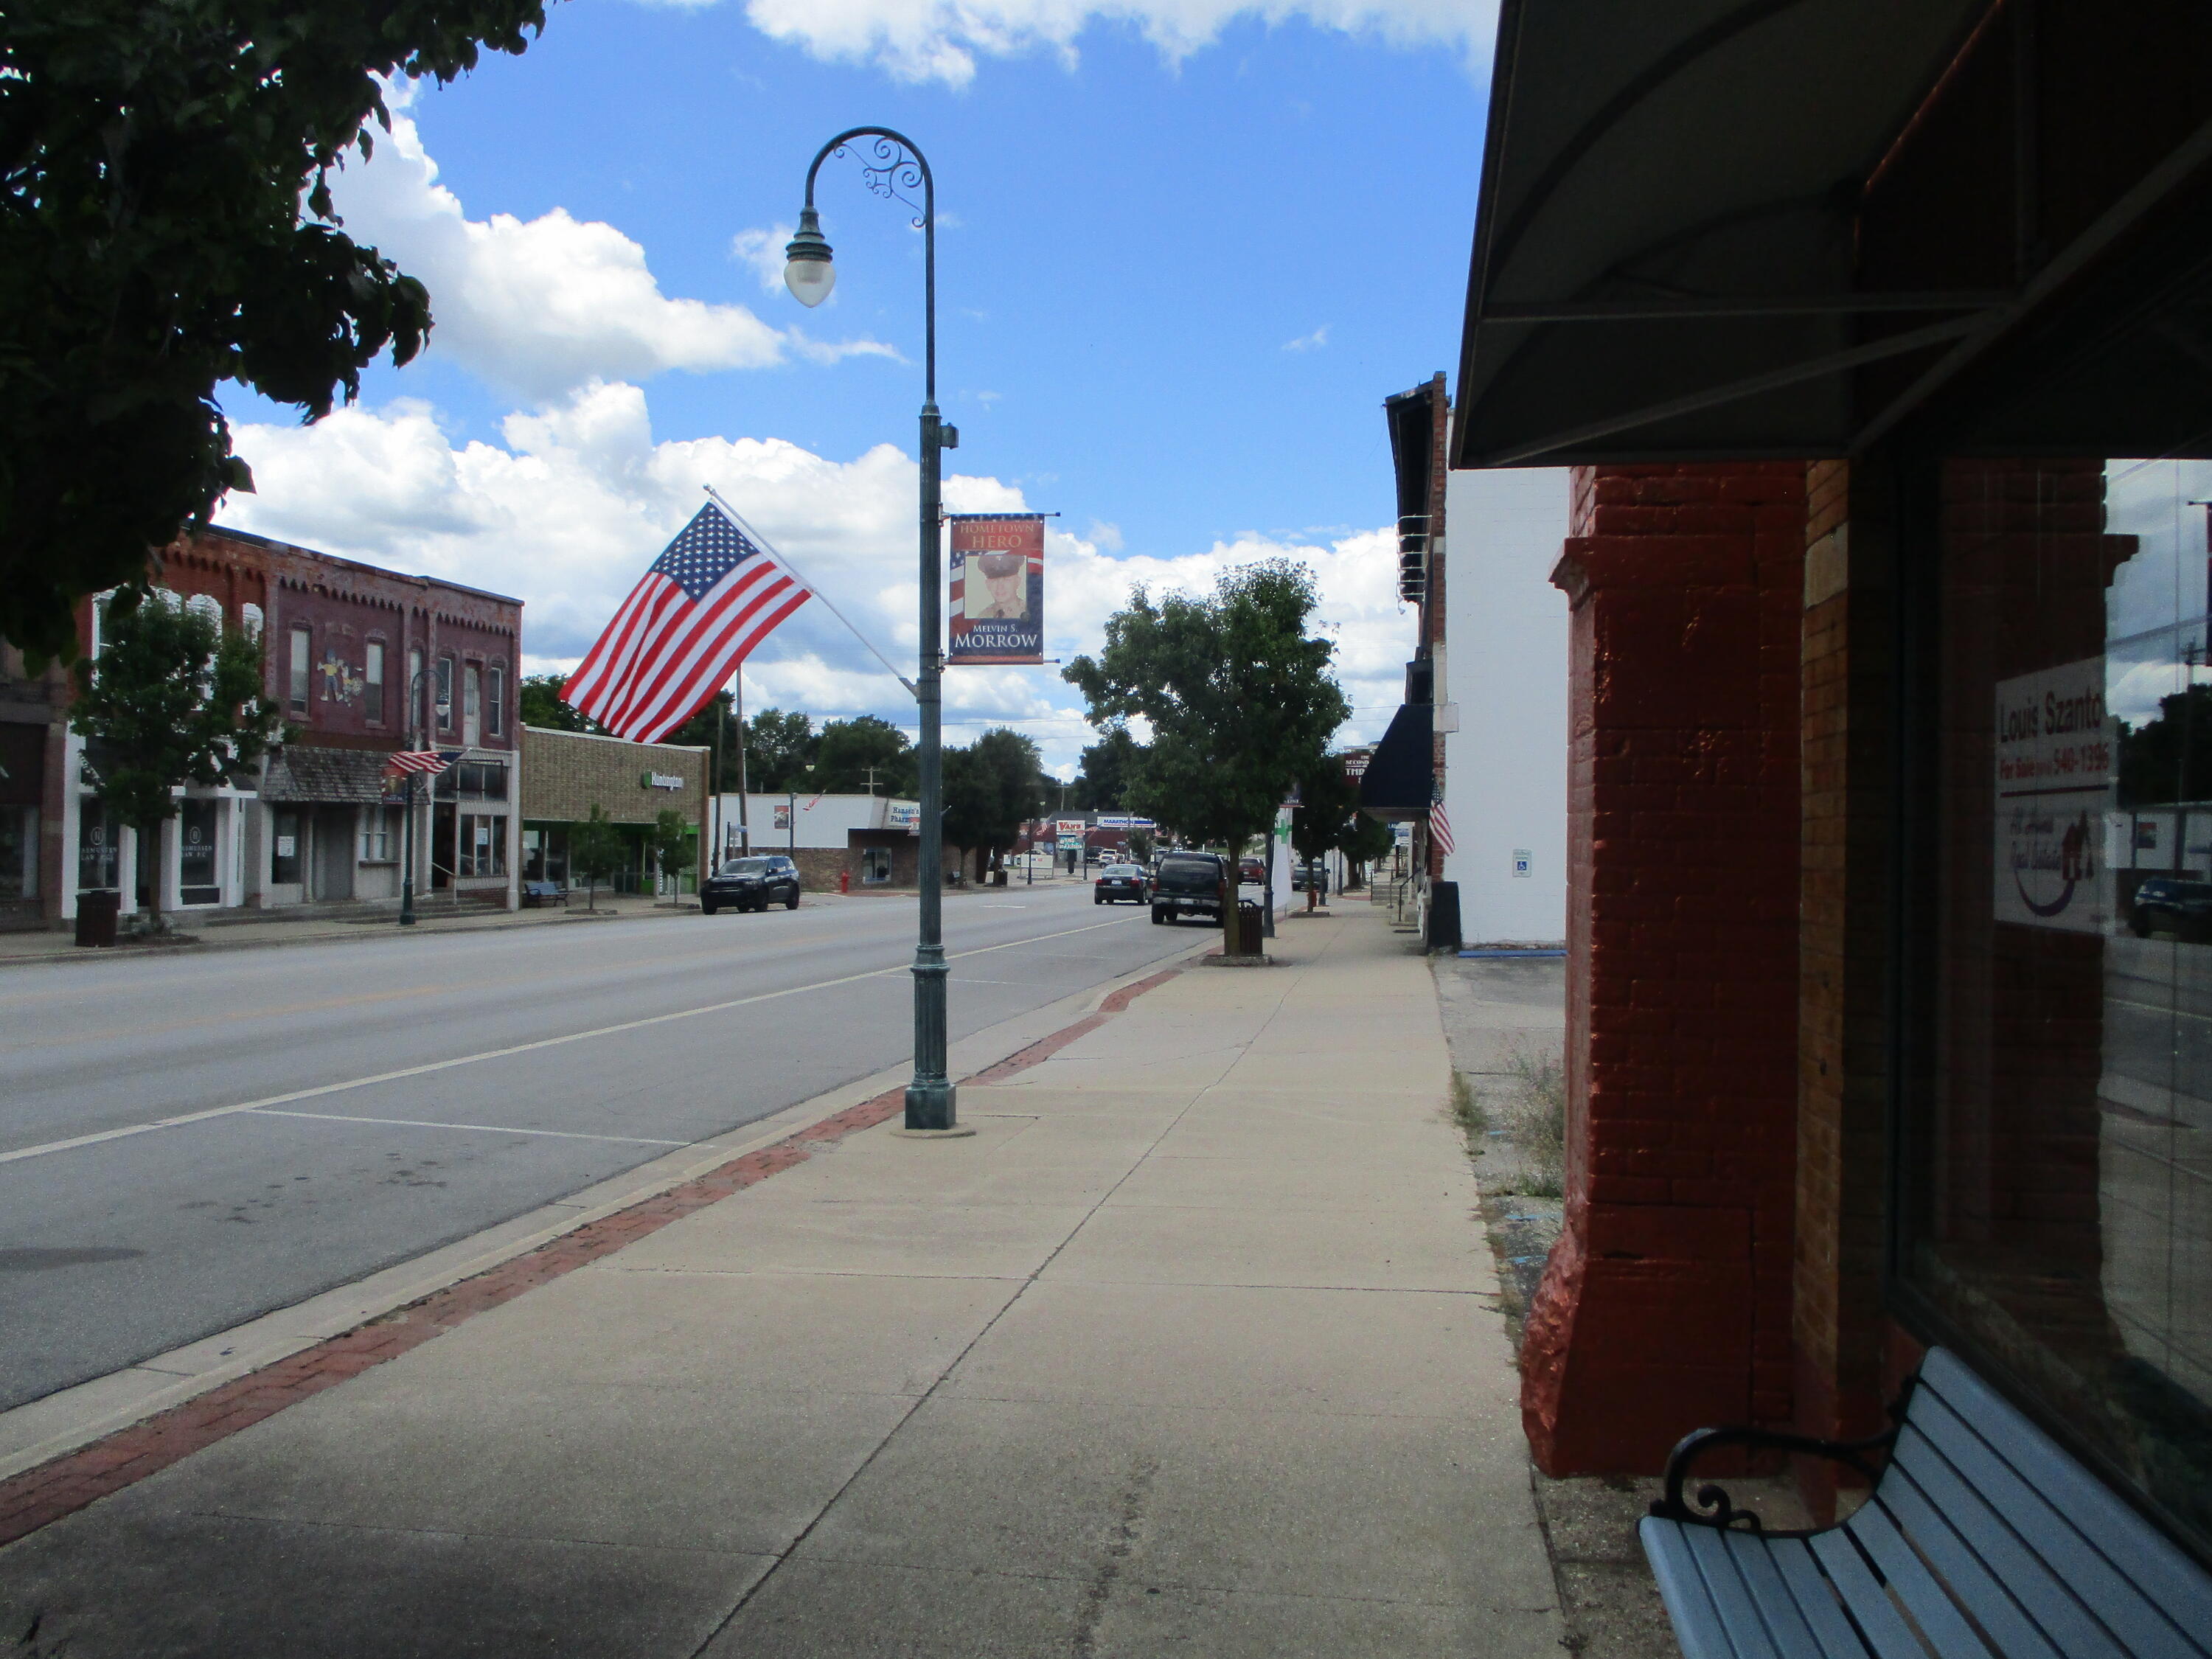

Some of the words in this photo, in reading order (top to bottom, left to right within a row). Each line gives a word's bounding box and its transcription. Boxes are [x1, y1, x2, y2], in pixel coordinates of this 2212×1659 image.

[960, 524, 1034, 534] HOMETOWN
[973, 535, 1022, 548] HERO
[955, 633, 1037, 648] MORROW
[2000, 696, 2038, 743] Louis
[2045, 686, 2102, 734] Szanto
[651, 771, 684, 790] Huntington
